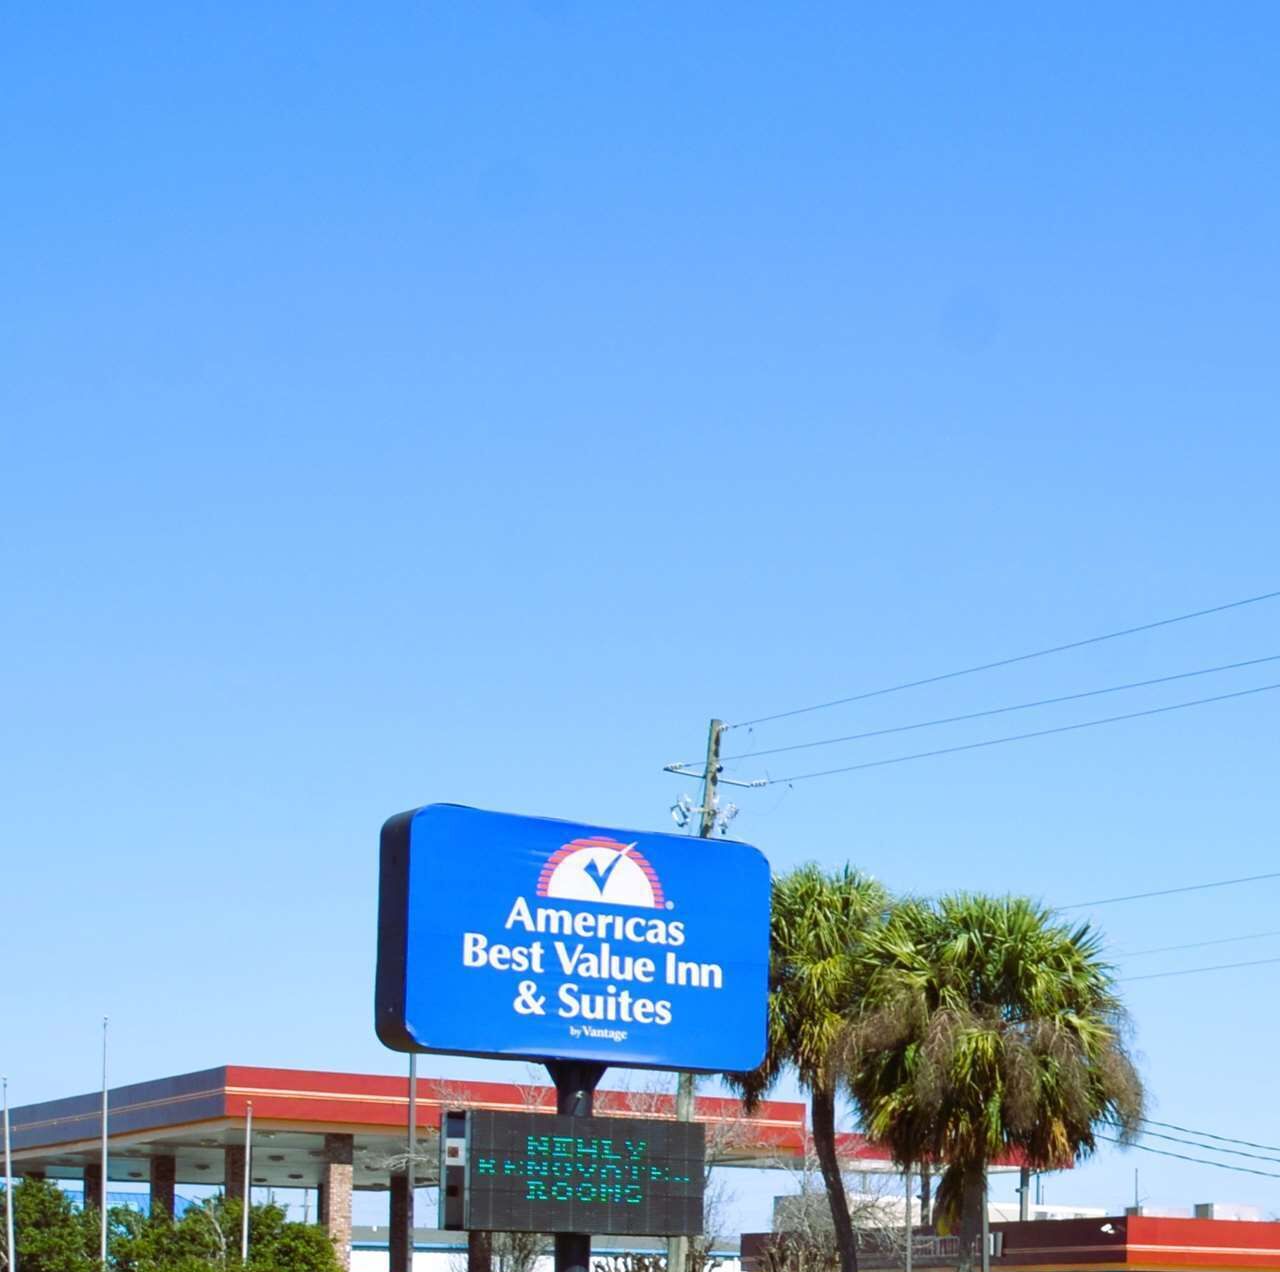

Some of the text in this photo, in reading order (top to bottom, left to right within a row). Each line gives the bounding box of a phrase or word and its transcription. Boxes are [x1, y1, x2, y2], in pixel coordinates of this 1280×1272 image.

[505, 896, 685, 946] Americas
[463, 932, 723, 989] Best Value Inn
[513, 980, 672, 1025] & Suites
[569, 1025, 628, 1042] by Vantage
[526, 1180, 643, 1203] ROOMS
